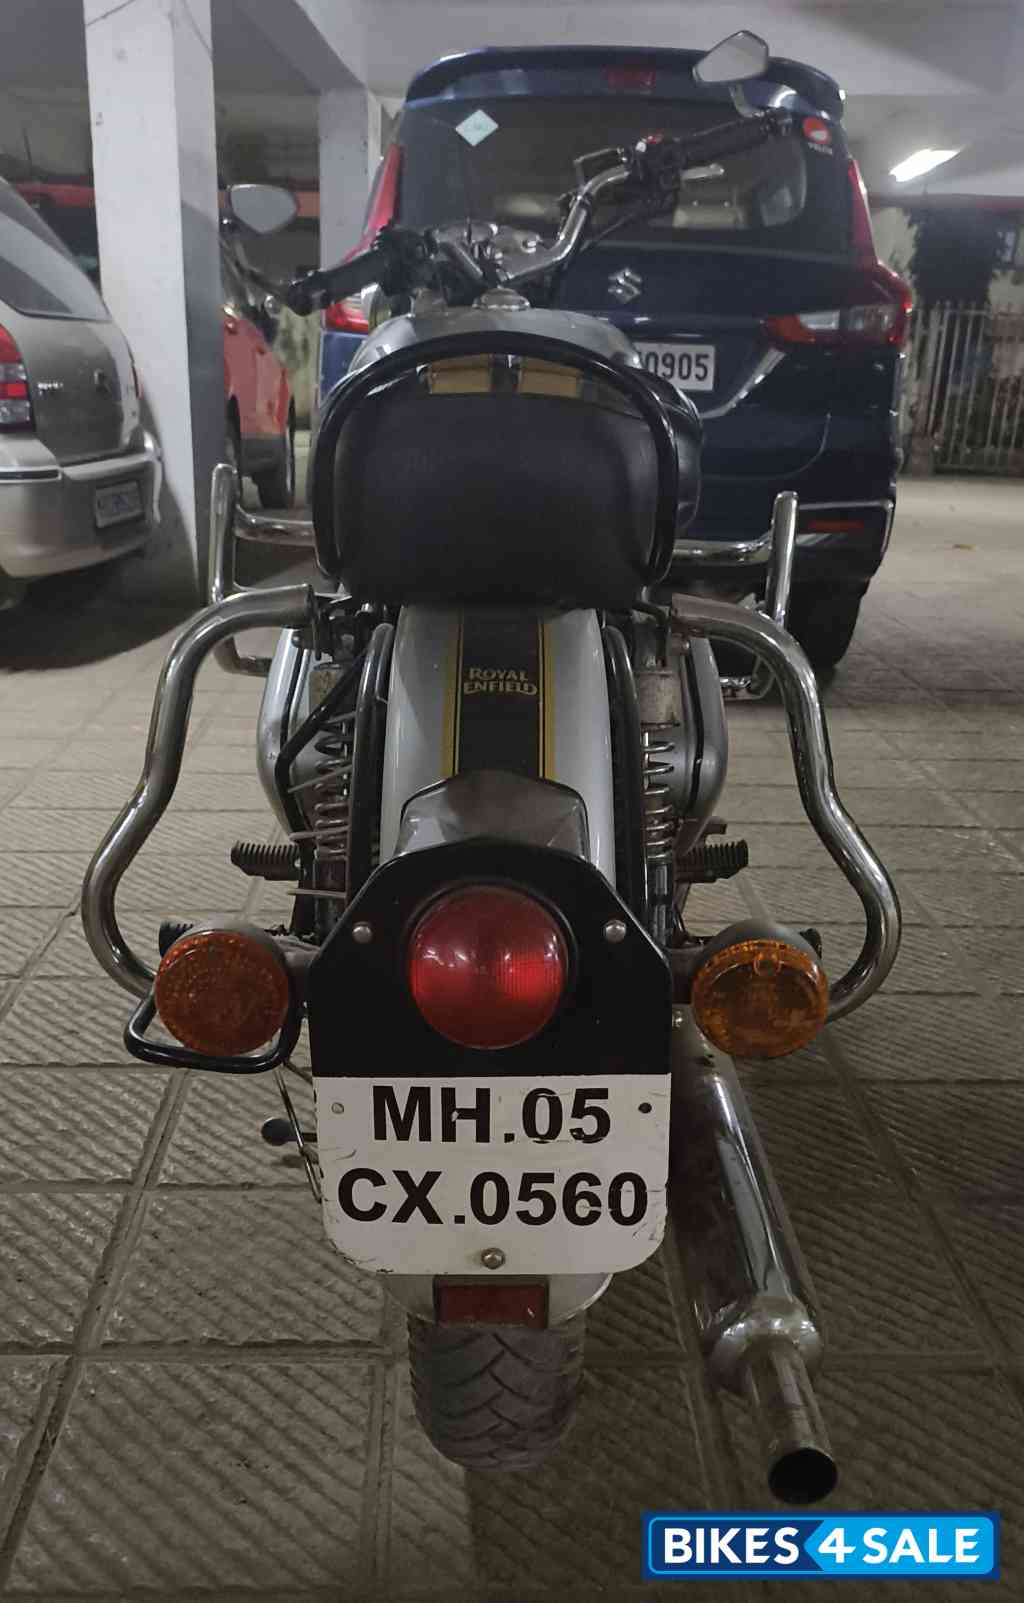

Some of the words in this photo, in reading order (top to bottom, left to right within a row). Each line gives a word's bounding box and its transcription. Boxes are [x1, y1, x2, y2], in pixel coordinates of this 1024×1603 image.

[463, 680, 538, 696] ENFIELD
[469, 666, 528, 681] ROYAL
[372, 1085, 611, 1144] MH.05
[337, 1167, 648, 1226] CX.0560
